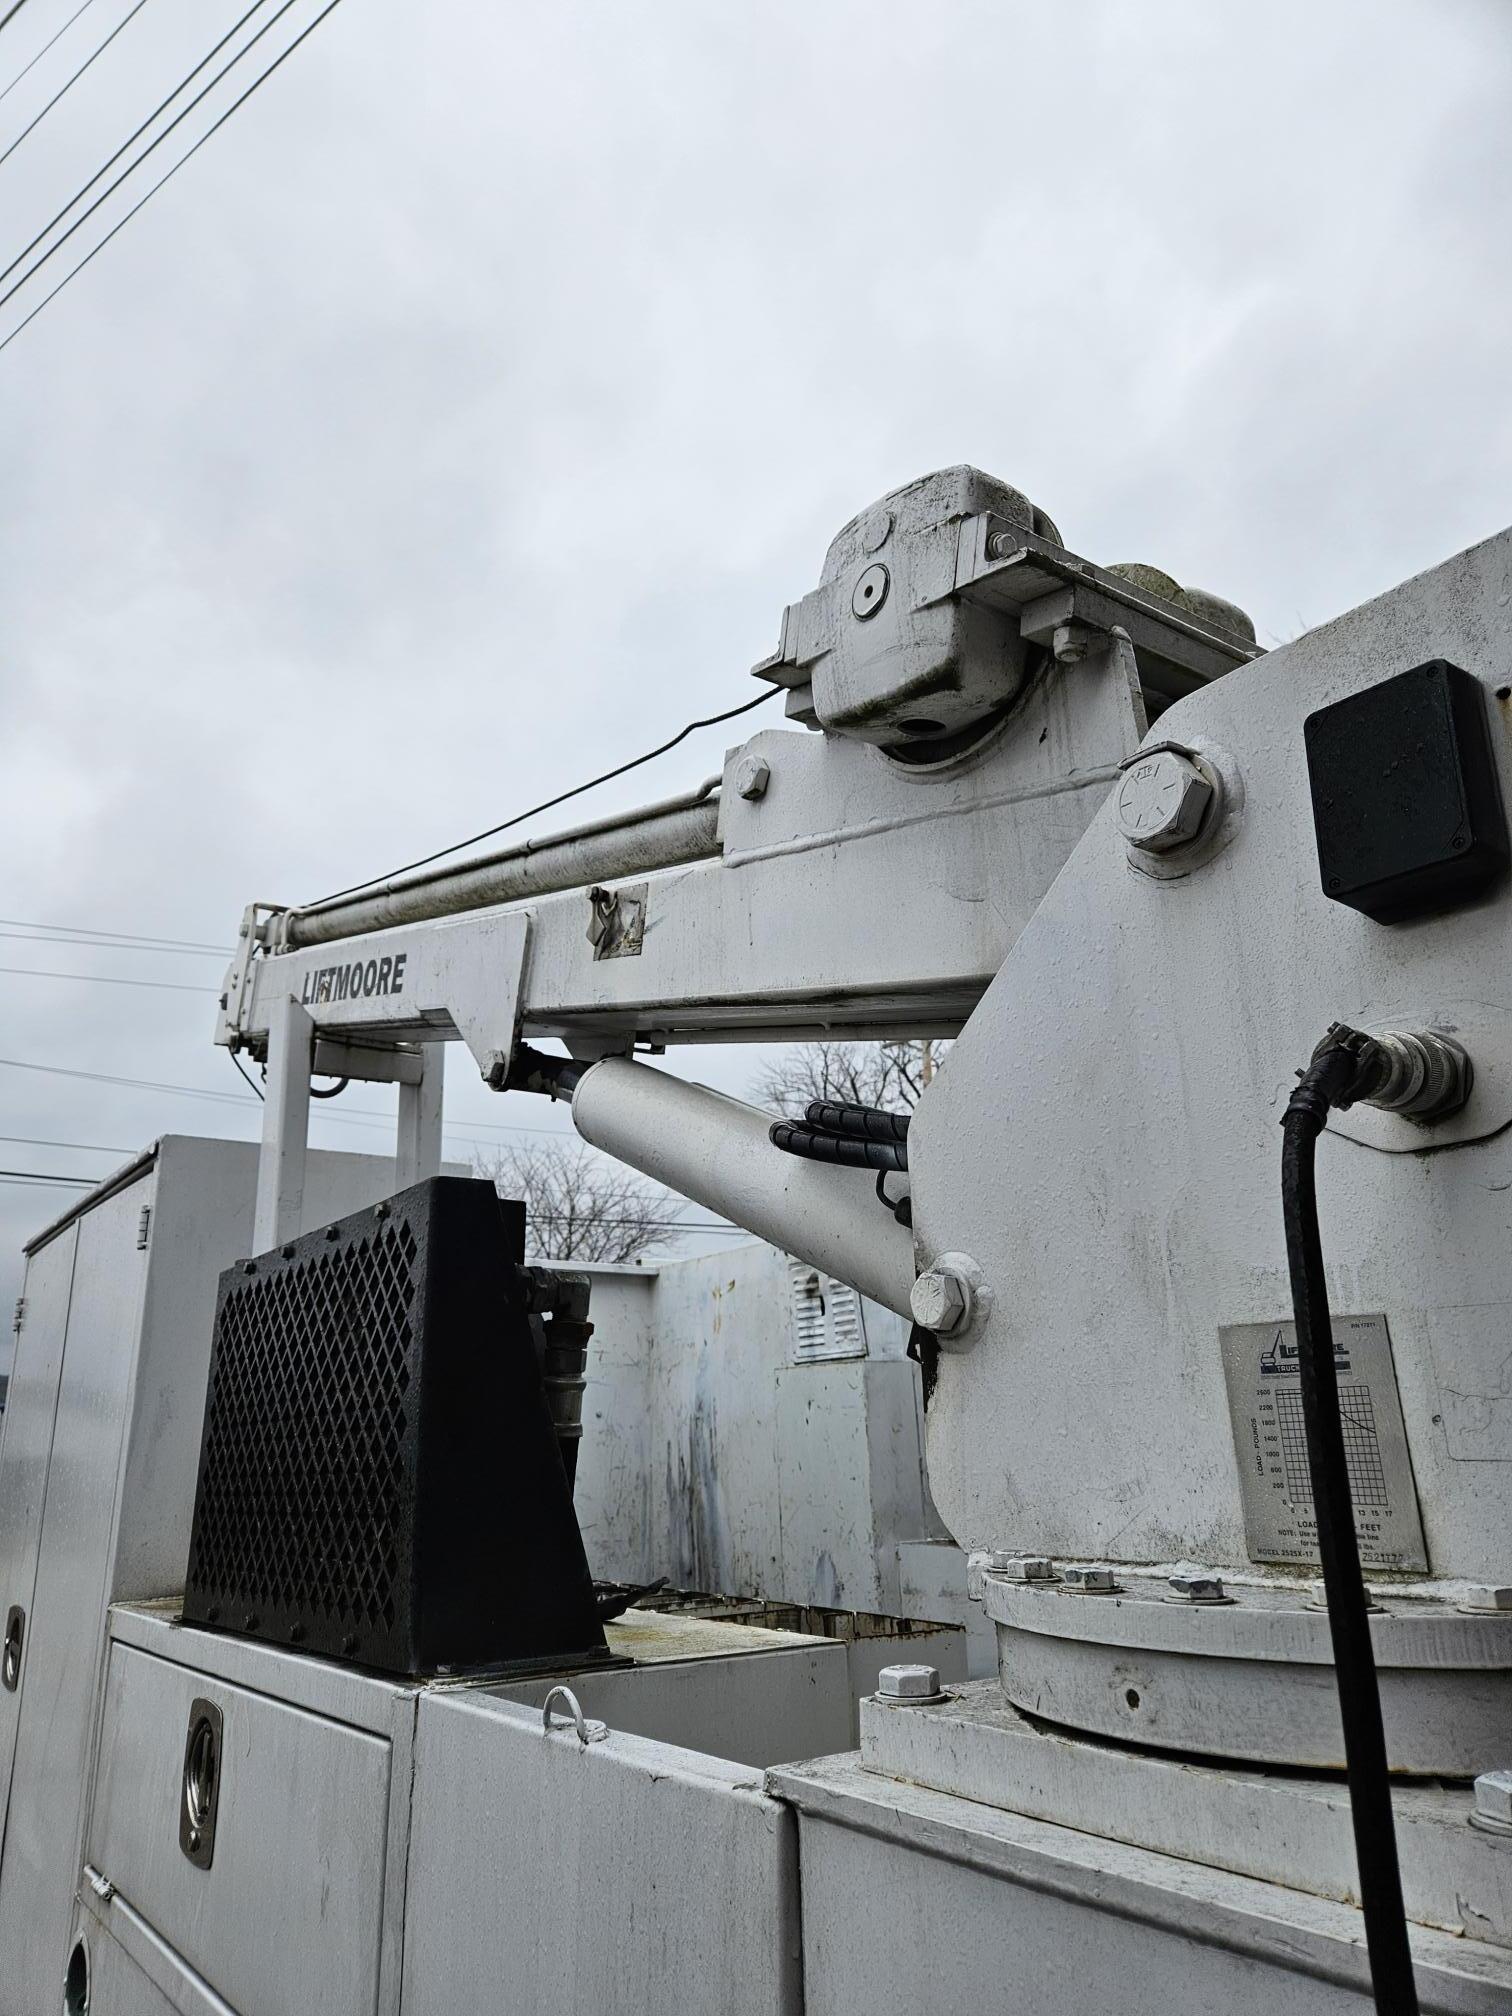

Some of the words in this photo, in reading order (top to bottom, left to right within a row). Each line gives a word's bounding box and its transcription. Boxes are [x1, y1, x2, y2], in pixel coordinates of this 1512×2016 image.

[302, 953, 407, 1005] LIFTMOORE
[1251, 1418, 1260, 1449] POUNDS
[1256, 1455, 1264, 1476] LOAD
[1360, 1523, 1381, 1531] FEET
[1257, 1548, 1280, 1556] MODEL
